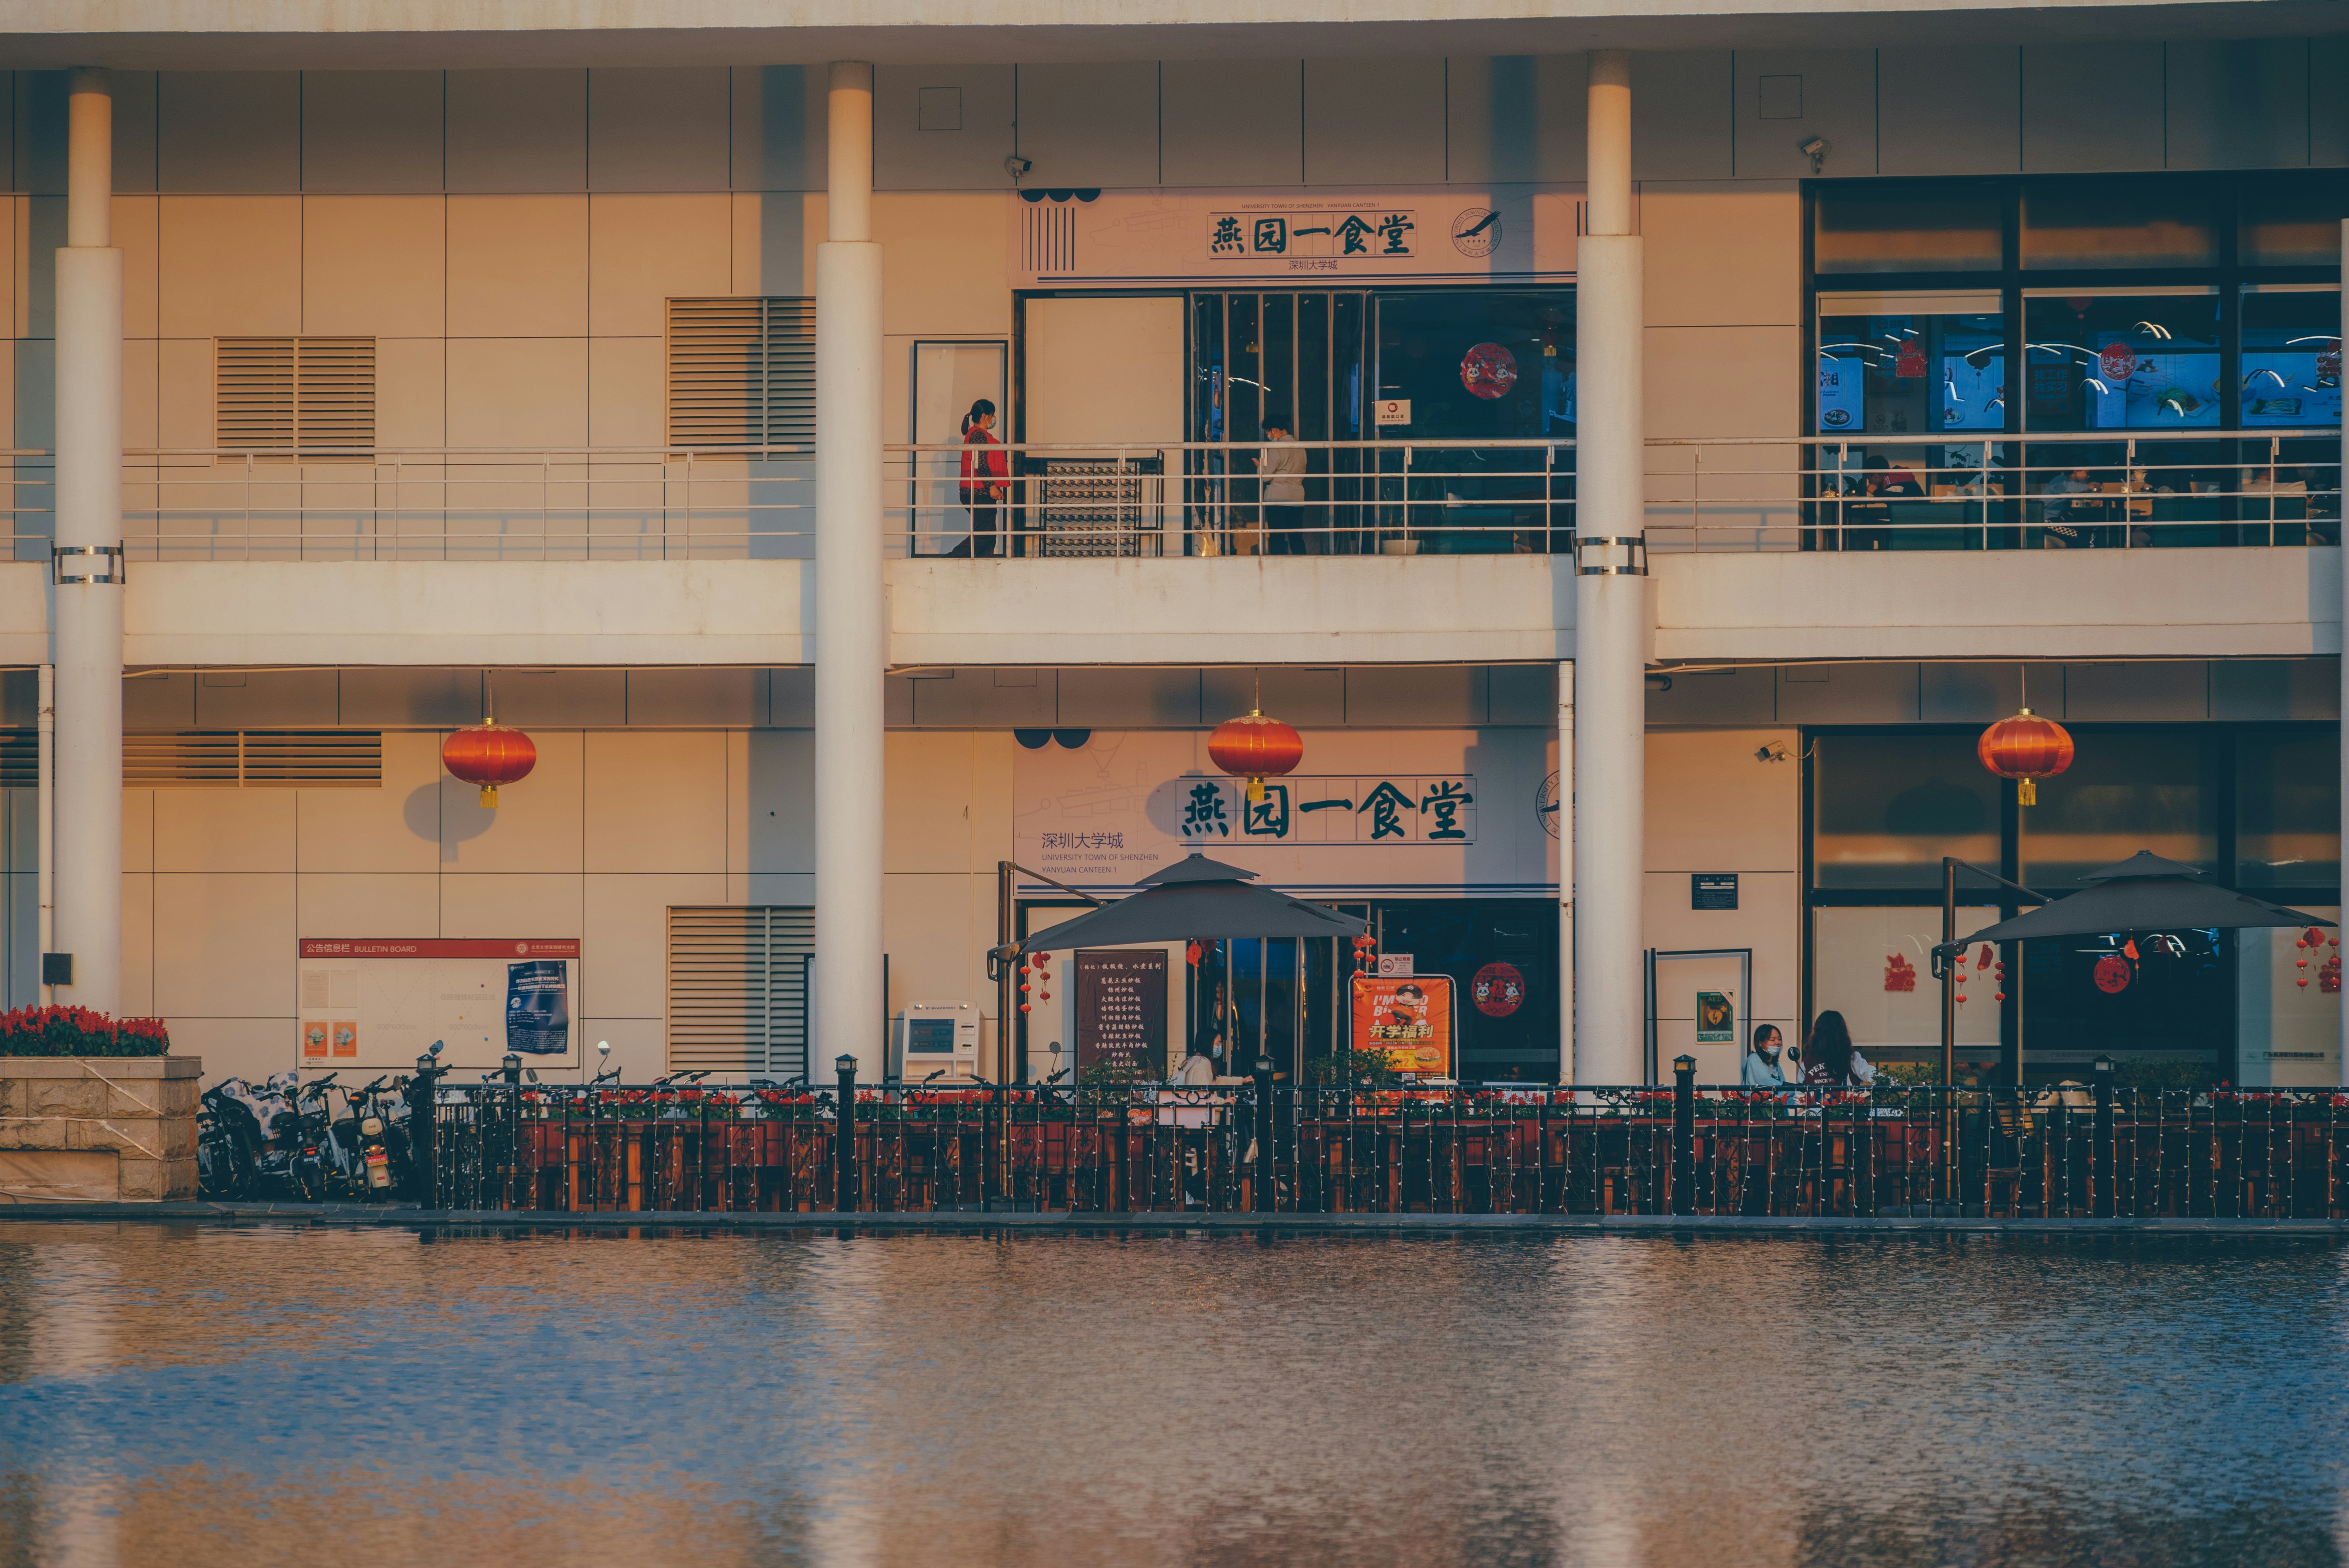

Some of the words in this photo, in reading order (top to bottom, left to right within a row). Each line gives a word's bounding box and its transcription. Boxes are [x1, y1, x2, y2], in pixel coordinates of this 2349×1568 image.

[1211, 214, 1414, 255] 燕园一食堂
[1289, 260, 1338, 270] 深圳大学城
[1182, 780, 1473, 840] 燕园一食堂
[1042, 832, 1123, 849] 深圳大学城
[306, 944, 350, 953] 公告信息栏
[1373, 995, 1395, 1005] I'M
[1369, 1025, 1434, 1038] 开学福利
